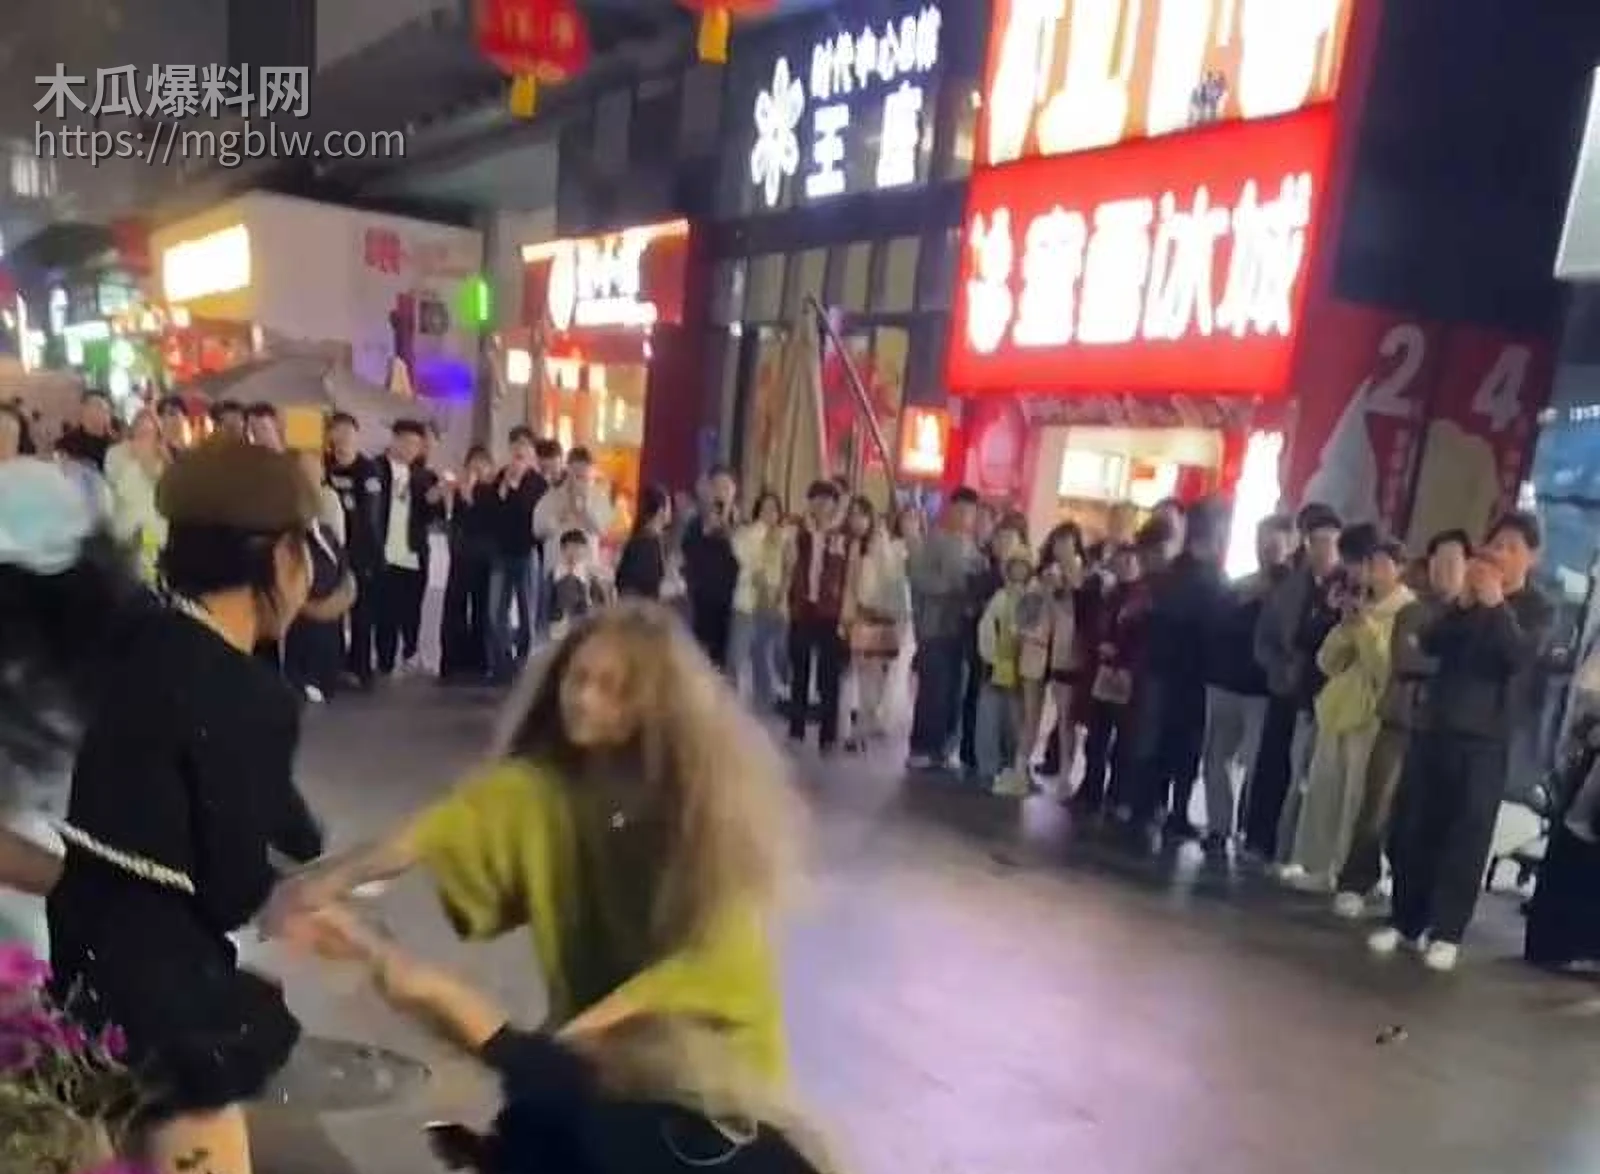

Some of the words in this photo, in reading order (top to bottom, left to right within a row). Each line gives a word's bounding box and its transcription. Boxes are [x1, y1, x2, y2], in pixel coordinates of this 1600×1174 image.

[1012, 170, 1313, 346] 蜜雪冰城
[1363, 323, 1426, 417] 2
[1470, 344, 1532, 431] 4
